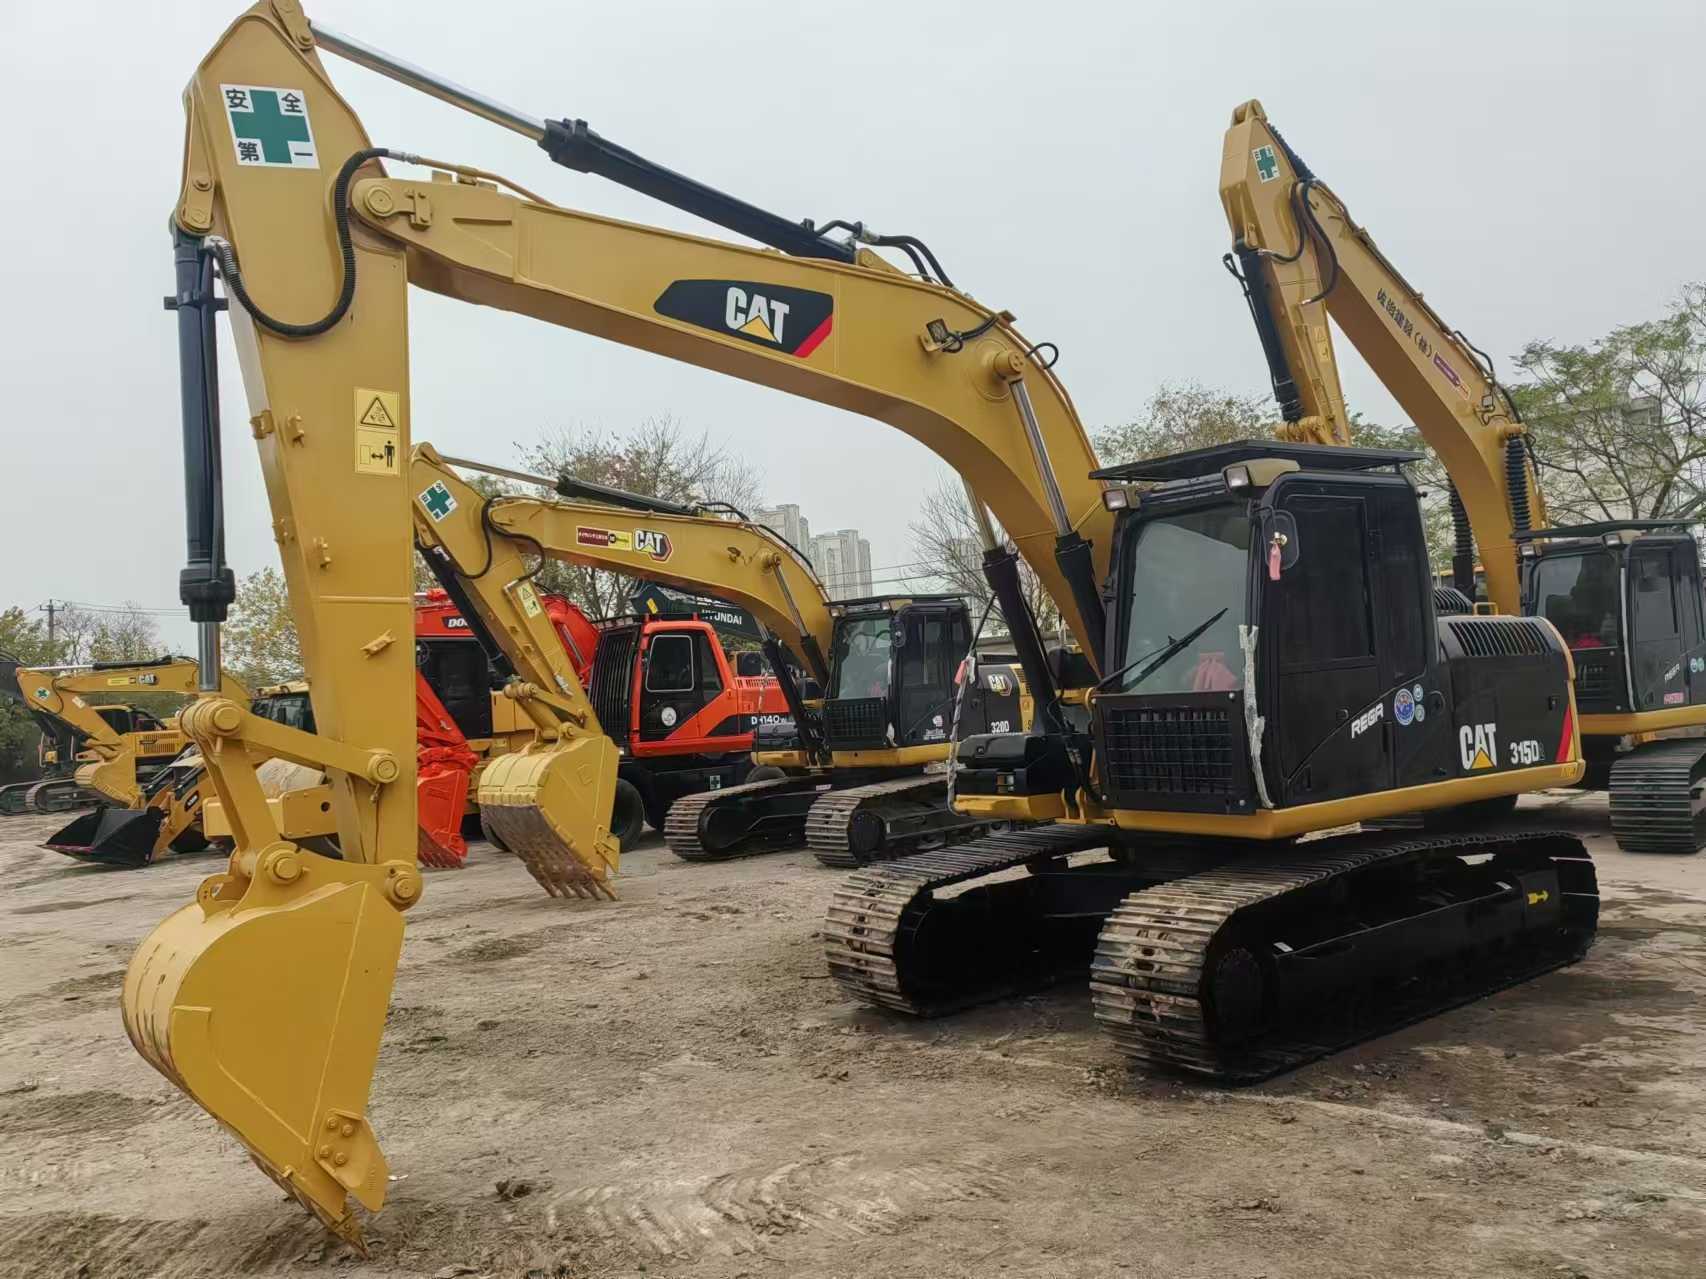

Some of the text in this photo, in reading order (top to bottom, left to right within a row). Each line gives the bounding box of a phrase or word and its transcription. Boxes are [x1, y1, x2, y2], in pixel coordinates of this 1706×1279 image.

[225, 88, 303, 113] 安全
[725, 286, 790, 344] CAT
[634, 529, 663, 554] CAT
[1351, 702, 1384, 739] REGA
[1459, 722, 1498, 770] CAT
